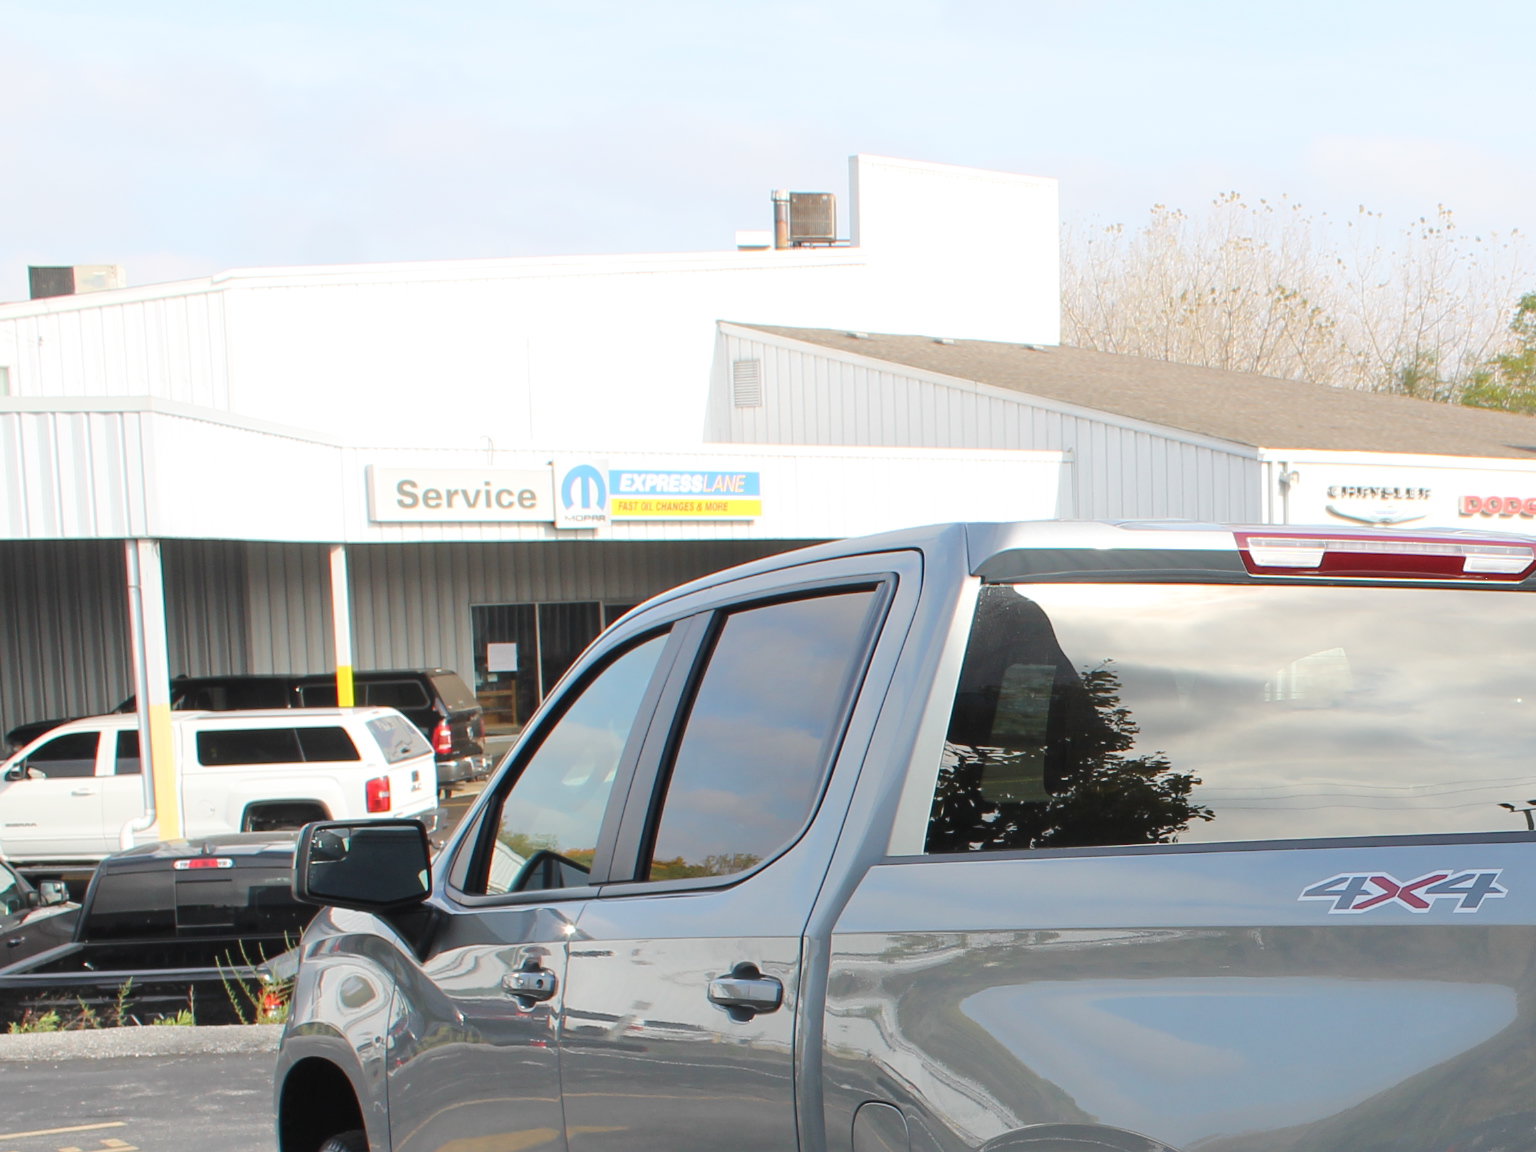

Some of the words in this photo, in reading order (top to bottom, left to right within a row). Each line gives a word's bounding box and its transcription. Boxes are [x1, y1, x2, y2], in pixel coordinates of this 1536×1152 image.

[396, 480, 537, 509] Service
[618, 502, 639, 512] FAST
[640, 502, 653, 512] OIL
[656, 502, 694, 512] CHANGES
[705, 503, 728, 512] MORE
[565, 514, 606, 522] MOPAR
